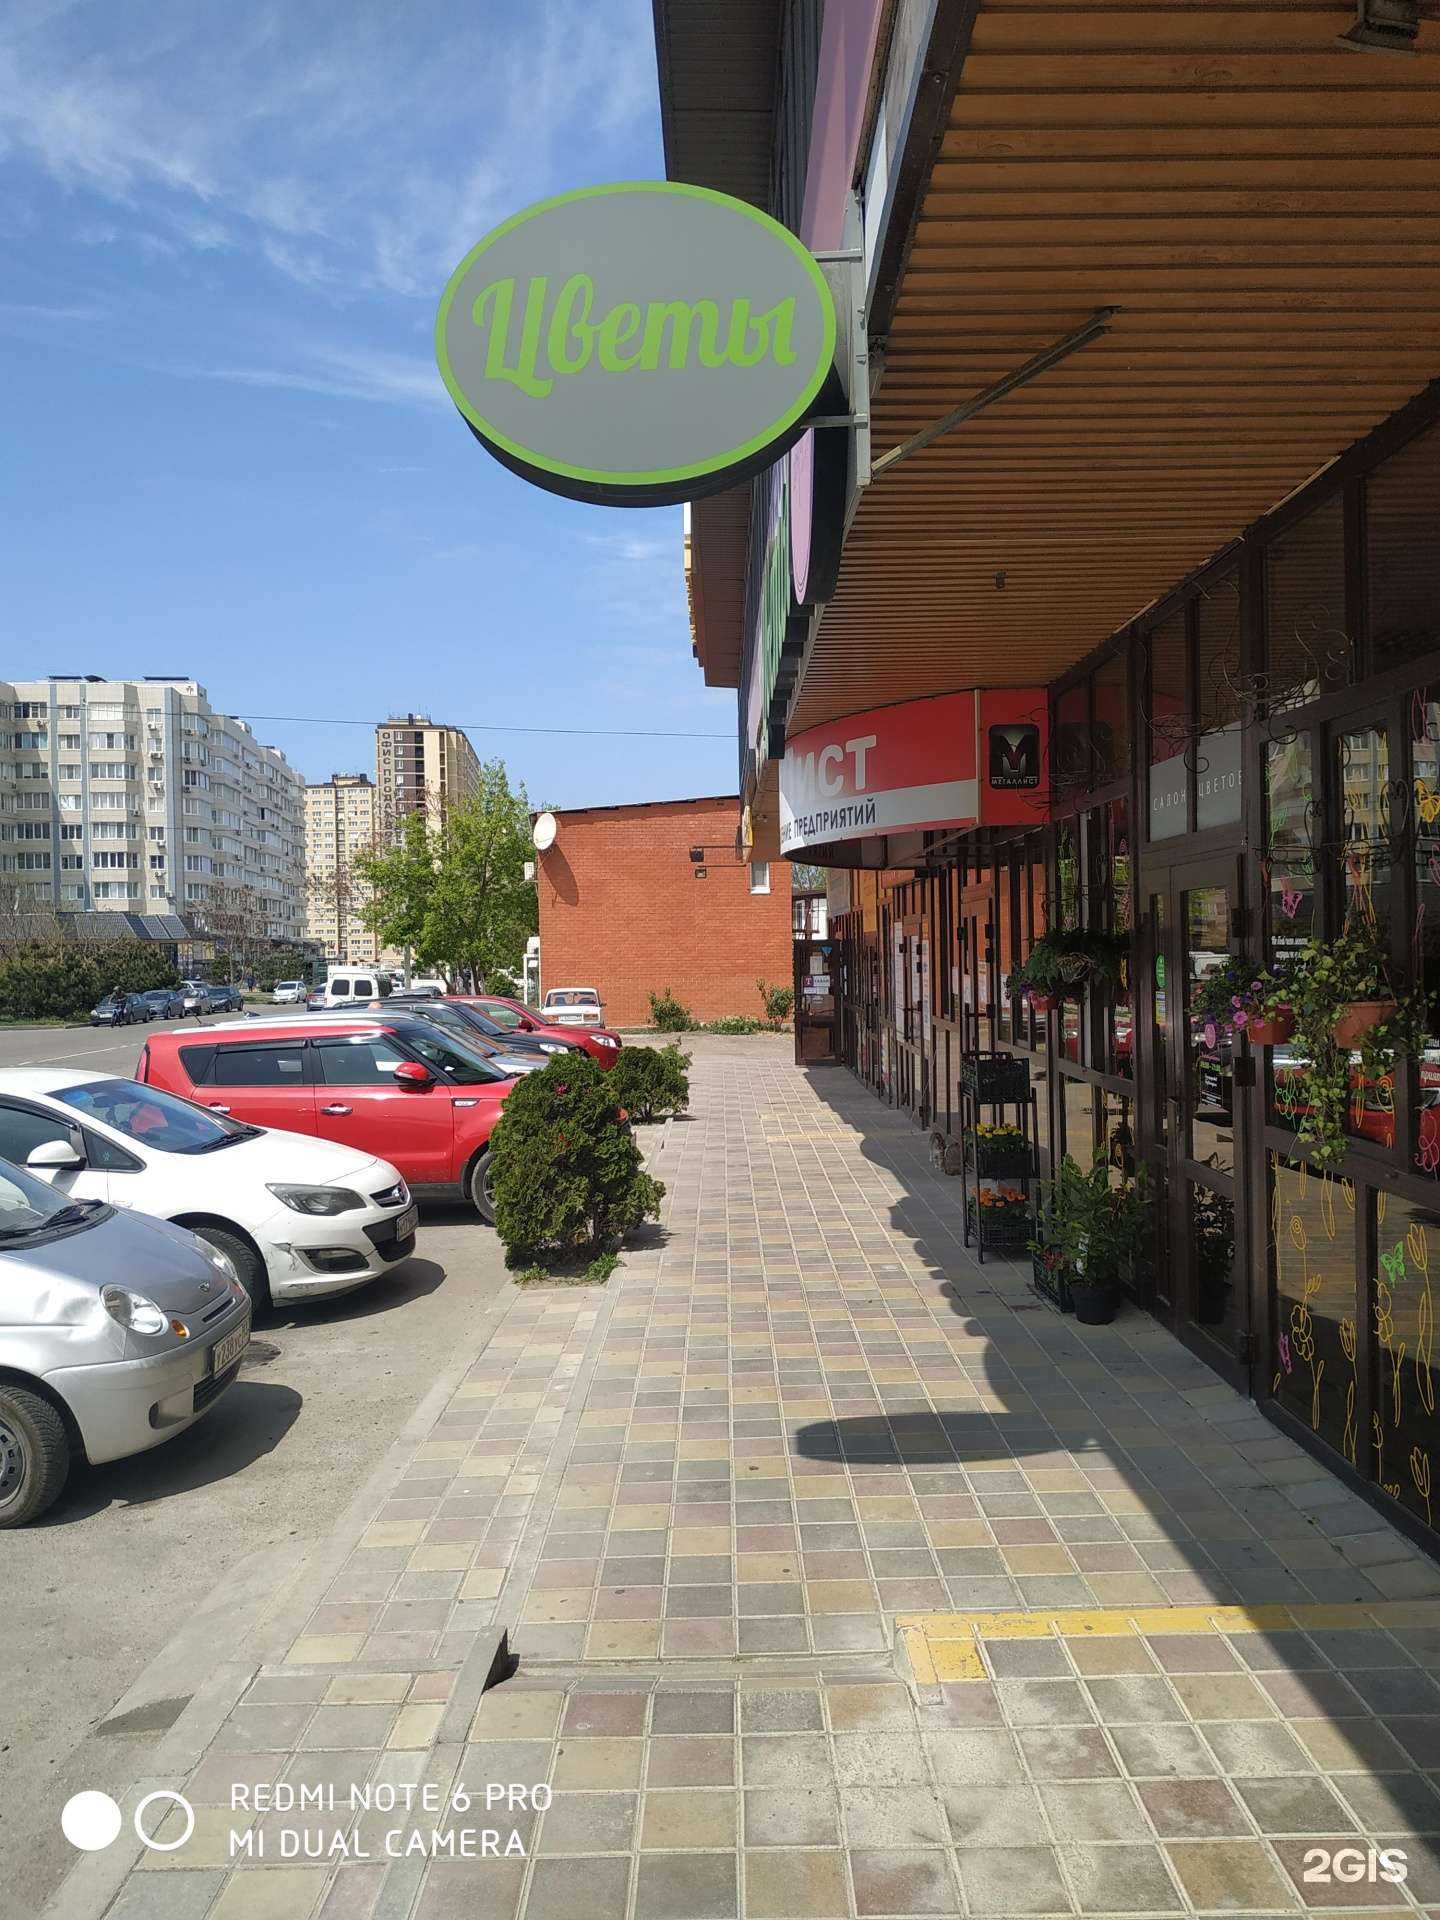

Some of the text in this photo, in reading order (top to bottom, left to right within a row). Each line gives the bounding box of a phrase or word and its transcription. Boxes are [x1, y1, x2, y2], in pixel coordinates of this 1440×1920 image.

[472, 273, 798, 399] Цветы
[381, 732, 392, 765] ОФИС
[794, 797, 876, 838] ПРЕДПРИЯТИЙ
